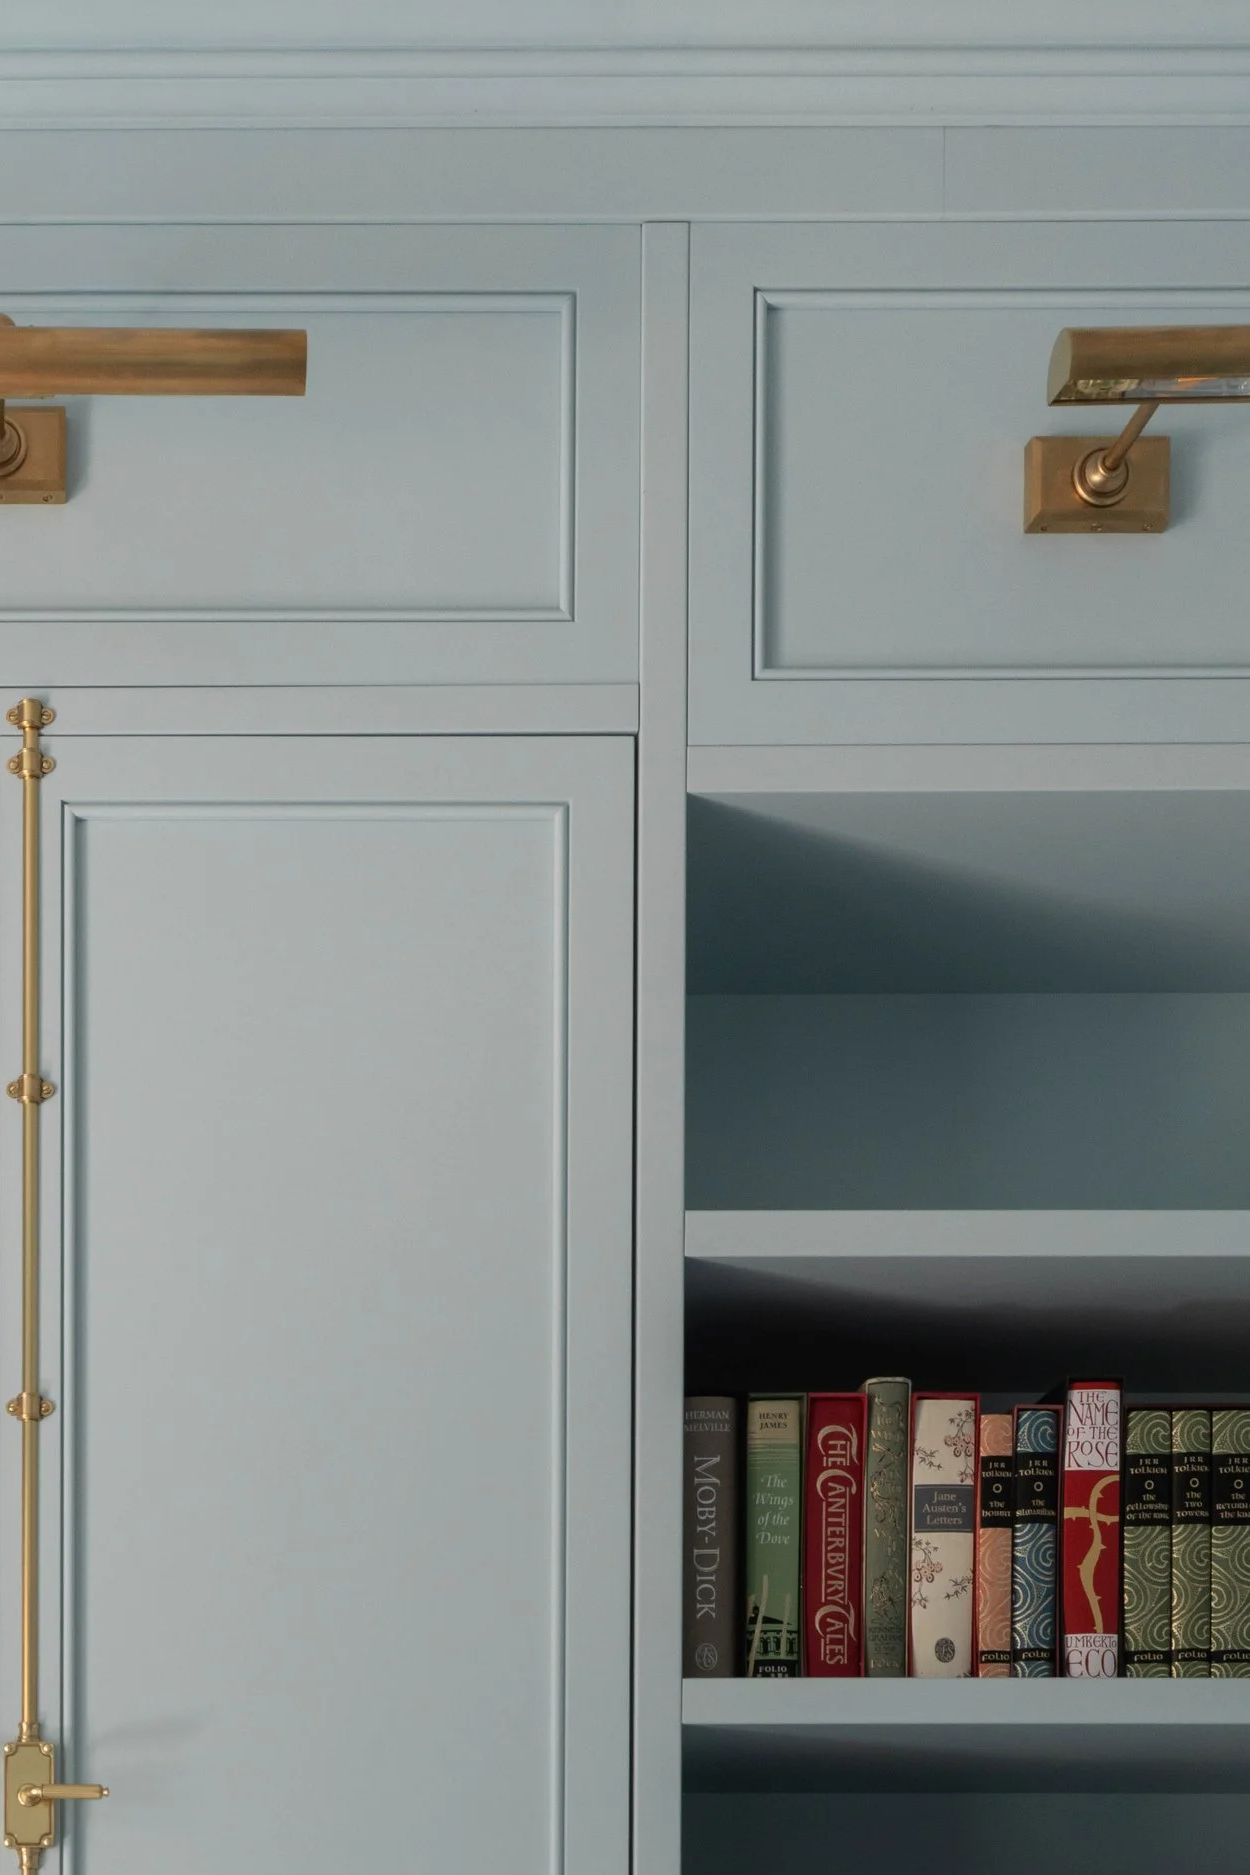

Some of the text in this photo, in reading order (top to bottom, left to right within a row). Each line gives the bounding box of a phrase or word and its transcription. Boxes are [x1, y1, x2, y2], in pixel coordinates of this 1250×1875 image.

[1078, 1391, 1107, 1403] THE
[685, 1410, 729, 1420] HERMAN
[758, 1412, 789, 1420] HENRY
[1068, 1399, 1118, 1426] NAME
[684, 1423, 731, 1432] MELVILLE
[759, 1422, 788, 1430] JAMES
[1066, 1426, 1118, 1440] OF THE
[817, 1423, 859, 1467] THE
[1067, 1441, 1118, 1468] ROSE
[761, 1473, 787, 1488] The
[753, 1492, 794, 1510] Wings
[933, 1491, 957, 1503] Jane
[922, 1502, 967, 1513] Austen's
[757, 1510, 789, 1528] of the
[926, 1515, 963, 1525] Letters
[693, 1455, 721, 1619] MOBY-DICK
[755, 1532, 790, 1545] Dove
[814, 1600, 857, 1665] TALES
[1065, 1635, 1117, 1649] UMBERTO
[758, 1665, 788, 1673] FOLIO
[1065, 1649, 1117, 1678] ECO
